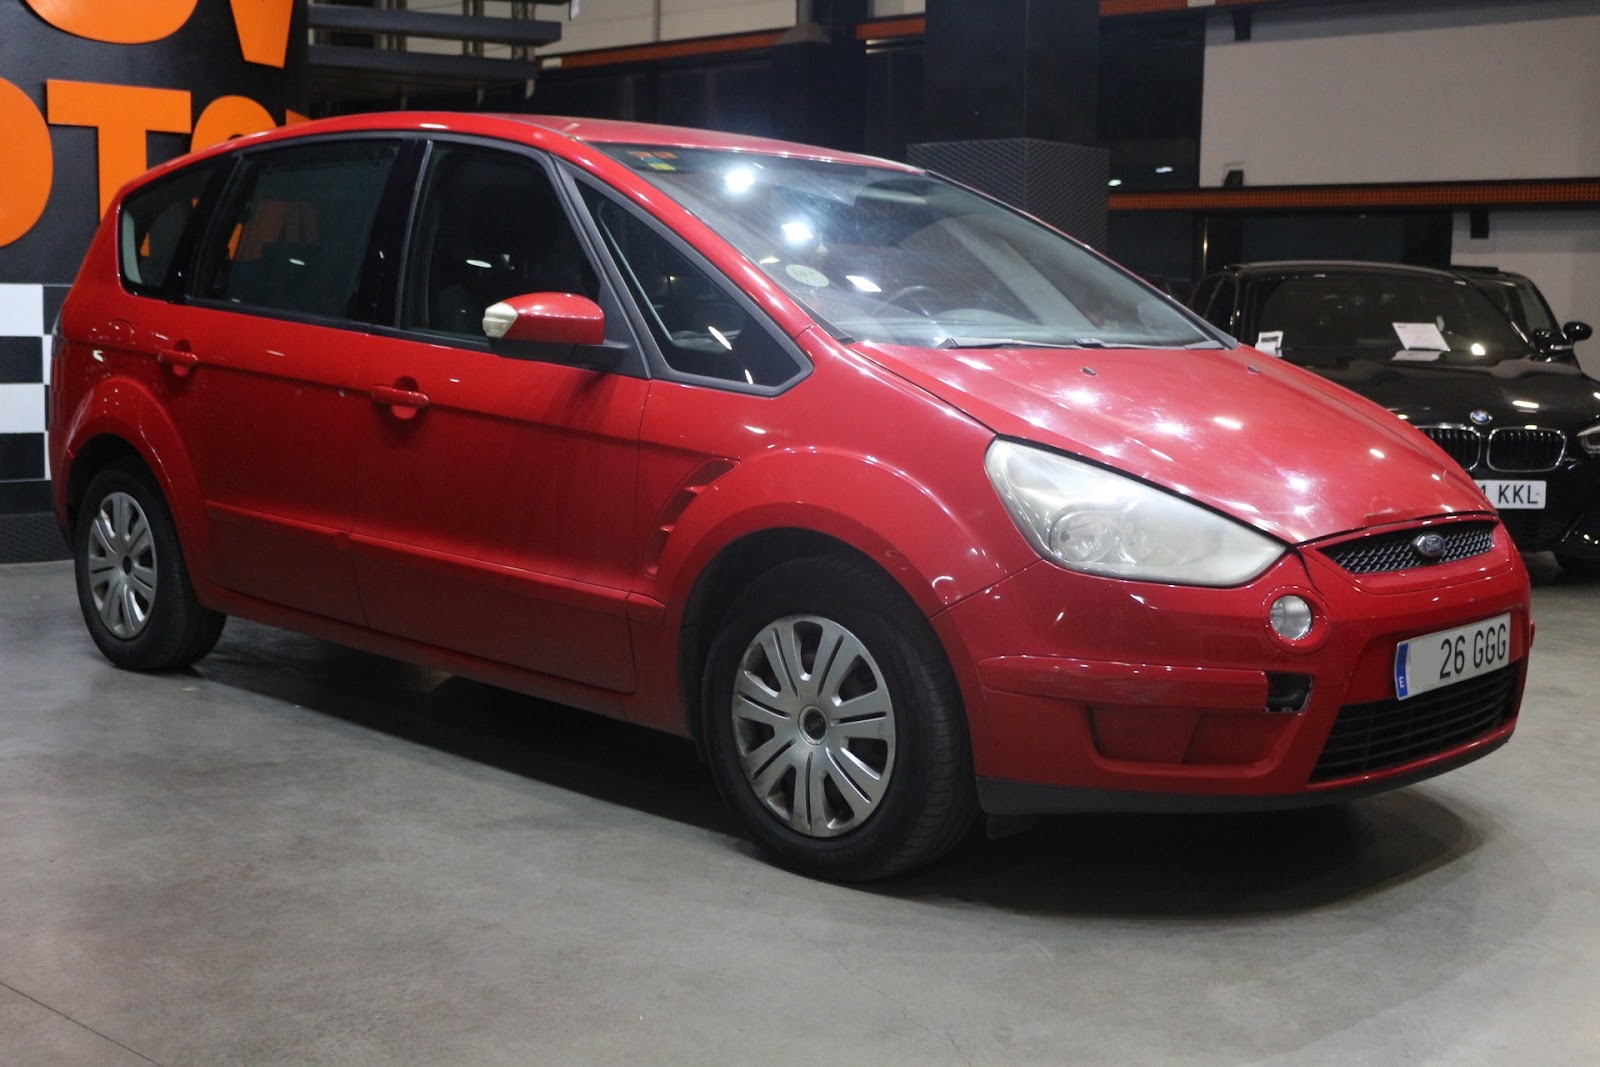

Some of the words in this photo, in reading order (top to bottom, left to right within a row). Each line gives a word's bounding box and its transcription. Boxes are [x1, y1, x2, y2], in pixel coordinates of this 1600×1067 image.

[1498, 484, 1538, 504] KKL
[1440, 635, 1466, 679] 26
[1473, 623, 1506, 668] GGG
[1399, 676, 1405, 689] E
